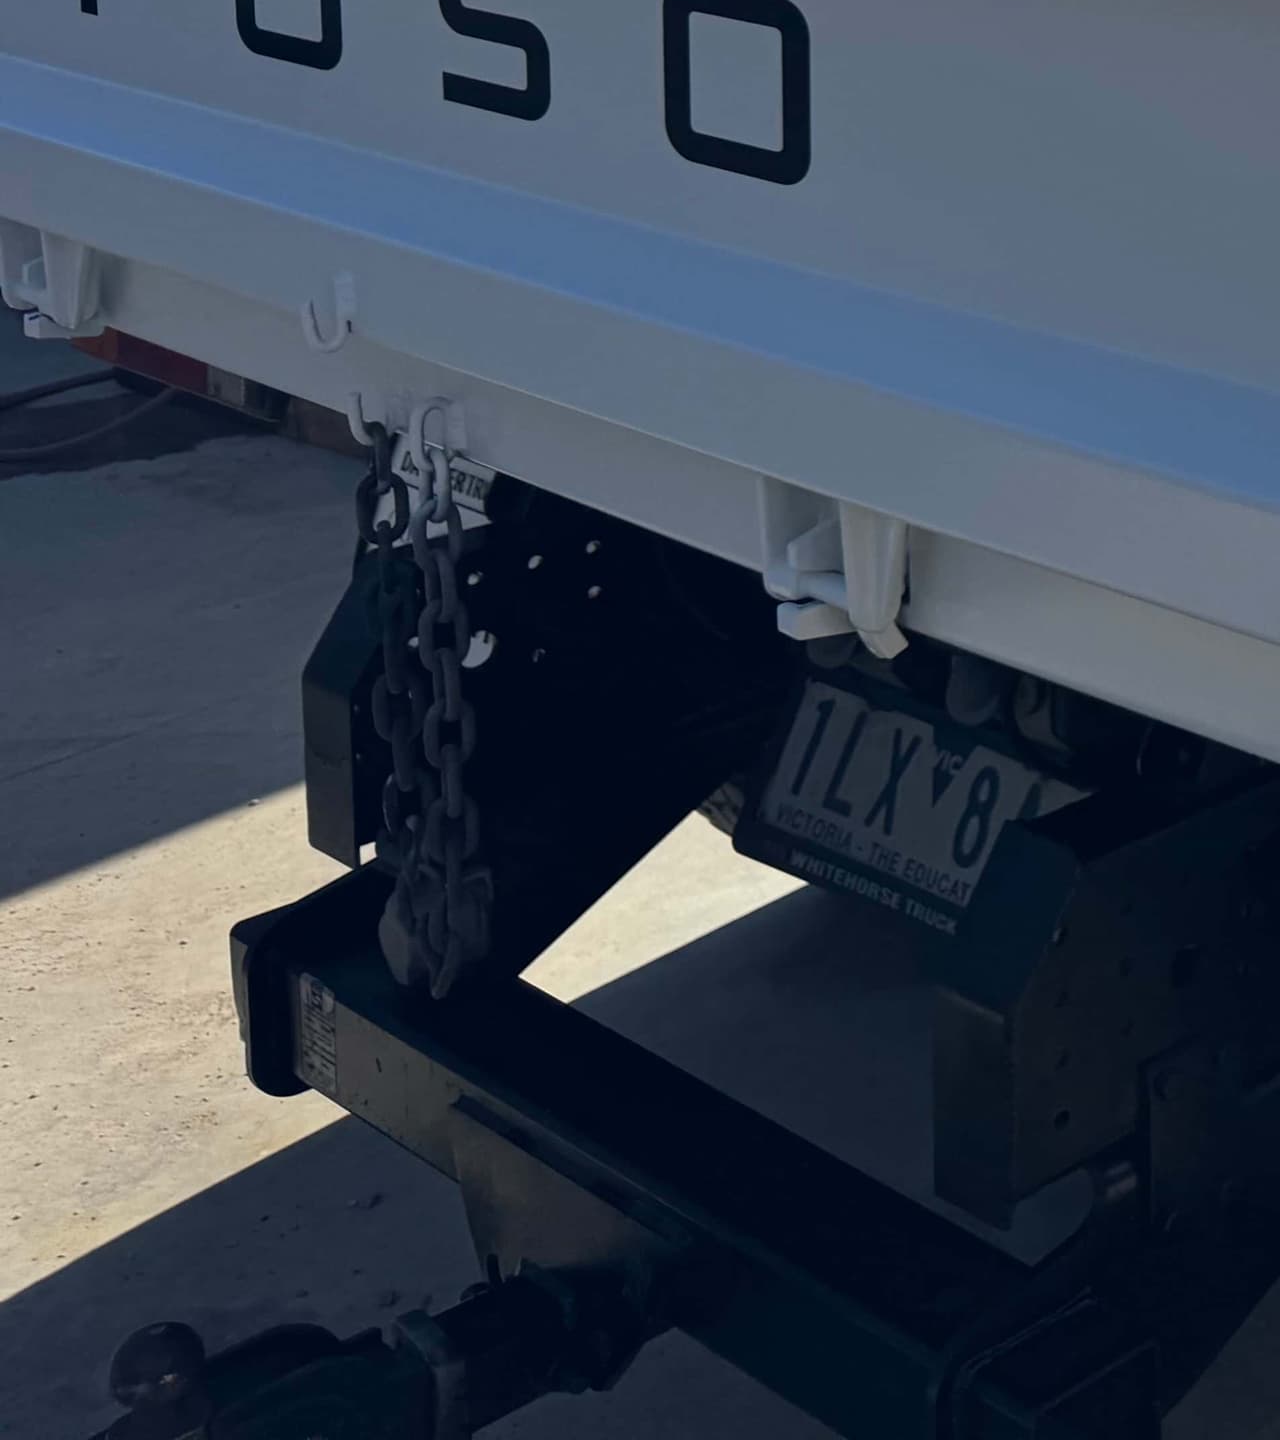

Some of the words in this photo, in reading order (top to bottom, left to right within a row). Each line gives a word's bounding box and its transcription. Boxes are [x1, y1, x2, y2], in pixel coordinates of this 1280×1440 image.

[776, 804, 852, 852] VICTORIA
[868, 842, 901, 871] THE
[789, 848, 903, 911] WHITEHORSE
[905, 896, 959, 936] TRUCK
